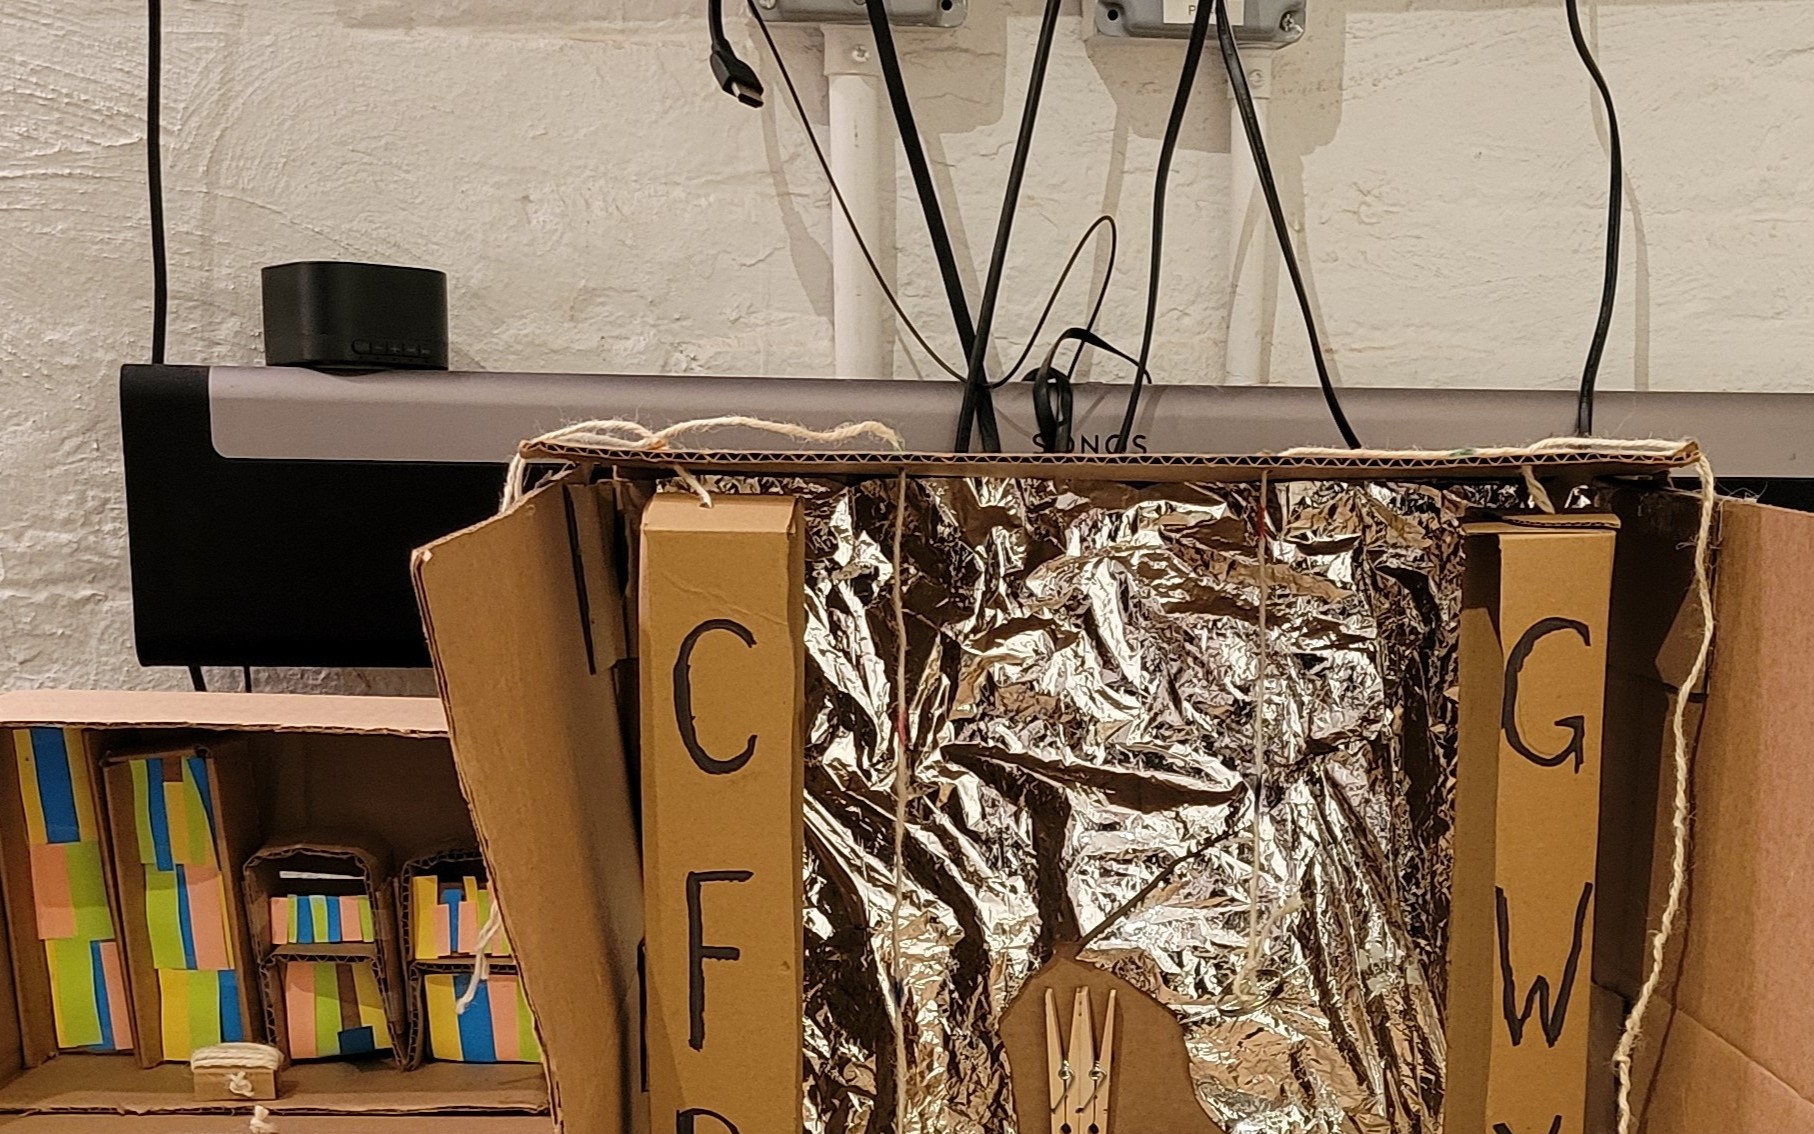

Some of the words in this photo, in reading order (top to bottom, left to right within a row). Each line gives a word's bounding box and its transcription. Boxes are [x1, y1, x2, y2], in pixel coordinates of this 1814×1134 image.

[672, 618, 758, 776] C
[1501, 616, 1591, 774] G
[685, 870, 755, 1053] F
[1494, 881, 1594, 1049] W
